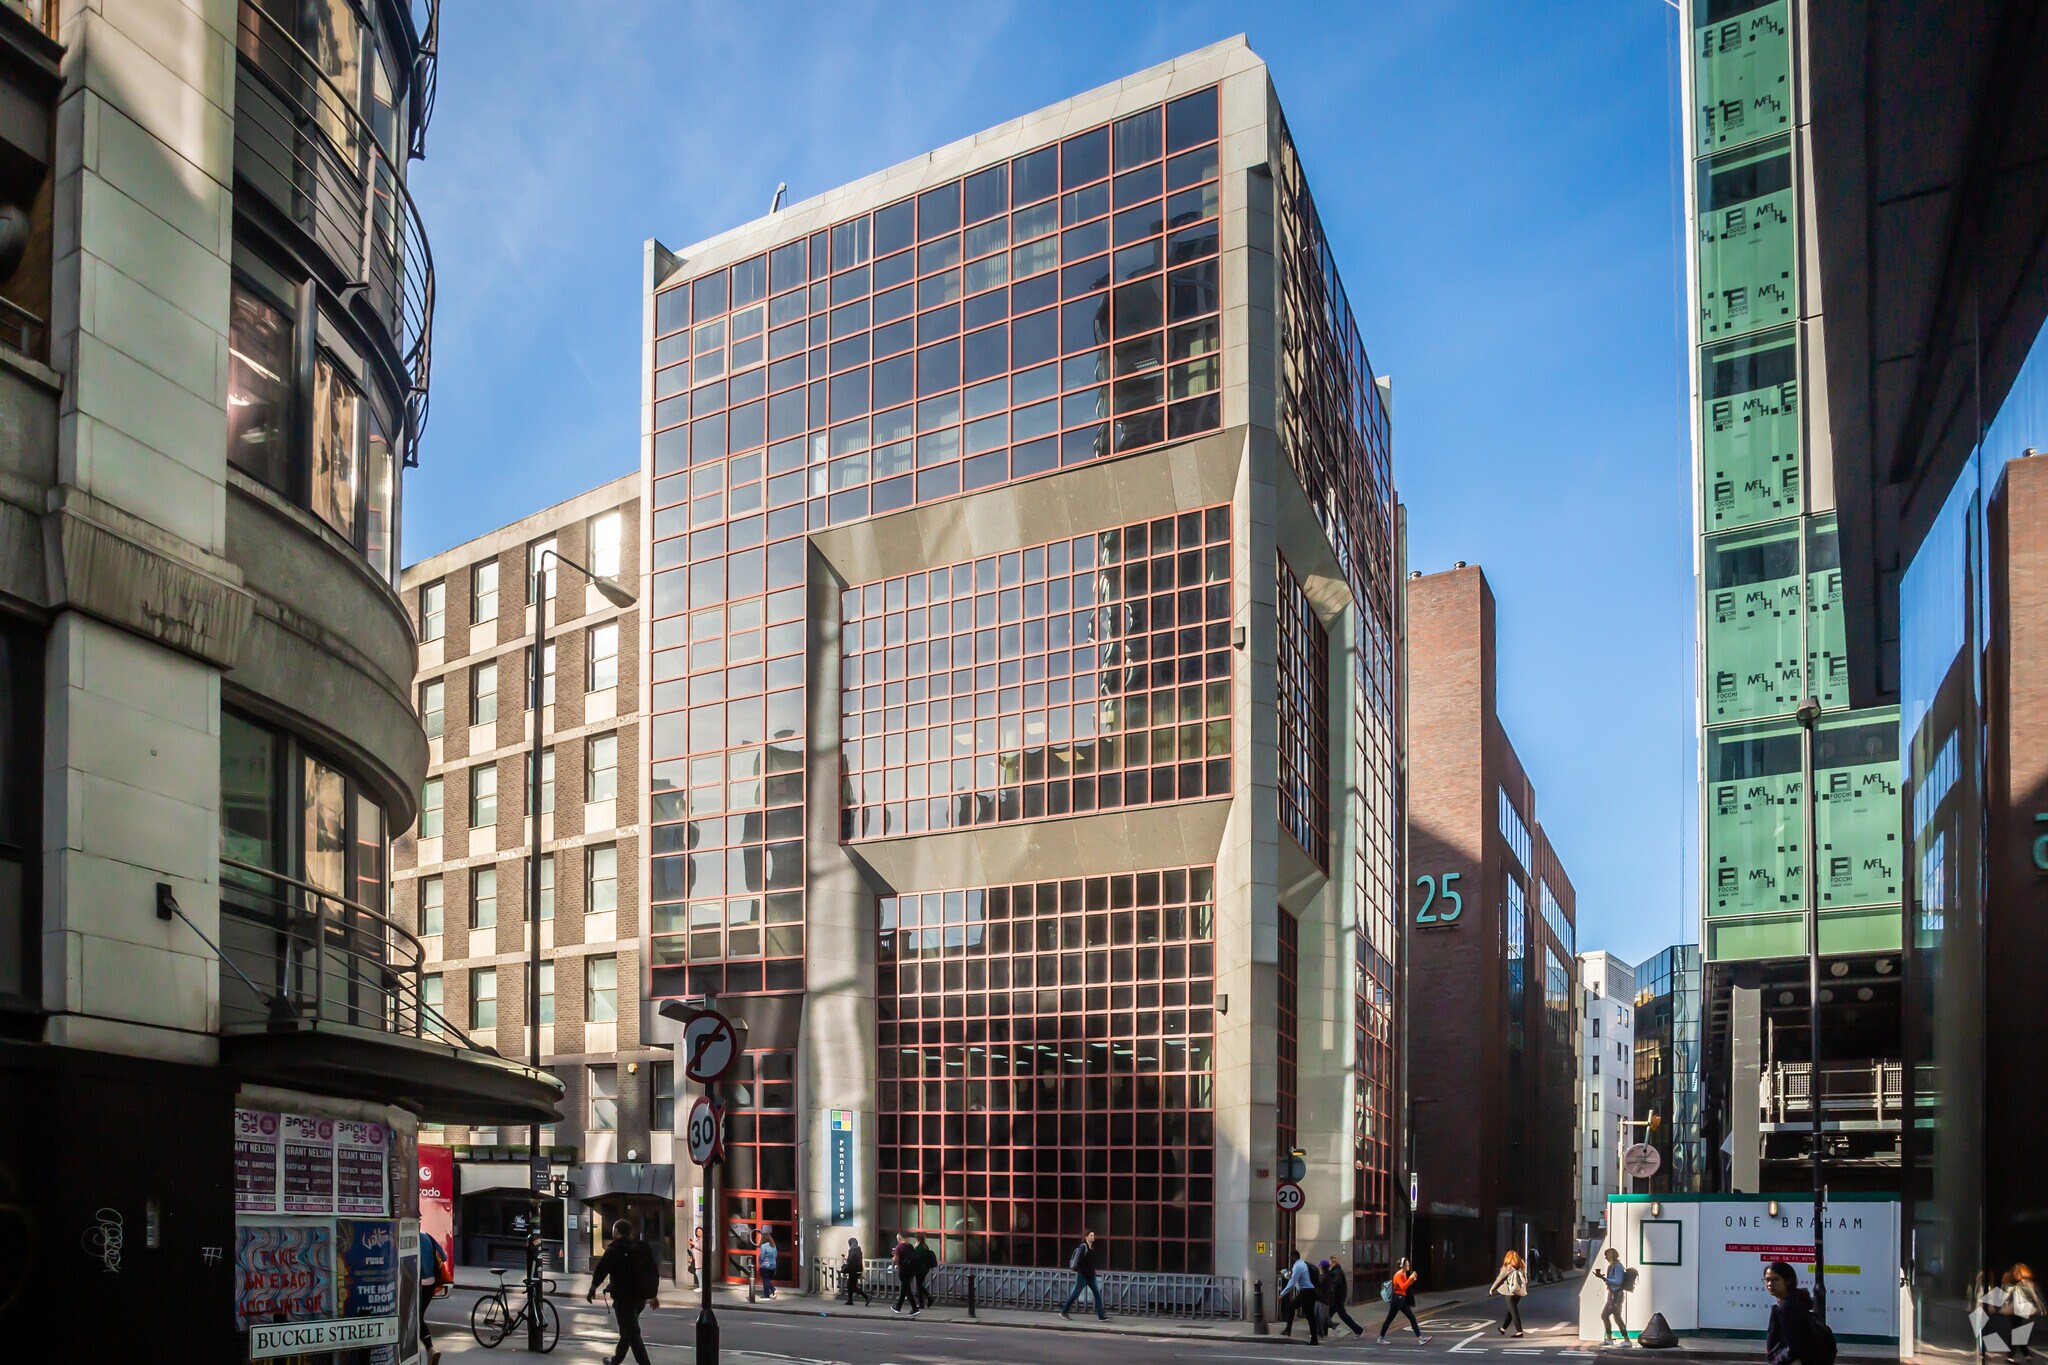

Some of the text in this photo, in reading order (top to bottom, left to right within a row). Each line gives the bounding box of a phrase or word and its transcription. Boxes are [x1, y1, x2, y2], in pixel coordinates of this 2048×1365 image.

[1416, 872, 1463, 924] 25
[235, 1112, 258, 1123] ACK
[691, 1115, 714, 1150] 30
[235, 1142, 275, 1155] ANT NELSON
[286, 1146, 332, 1158] GRANT NELSON
[339, 1150, 381, 1162] GRANT NELSON
[1278, 1191, 1299, 1204] 20
[1725, 1216, 1862, 1229] ONE BRAHAM
[1258, 1243, 1265, 1252] H
[260, 1249, 299, 1266] TAKE
[365, 1256, 384, 1265] FUSE
[245, 1271, 315, 1291] AN EXACT
[357, 1285, 376, 1295] THE
[239, 1297, 300, 1316] ACCOUNT
[257, 1327, 324, 1350] BUCKLE
[329, 1322, 385, 1342] STREET
[388, 1328, 396, 1336] E1
